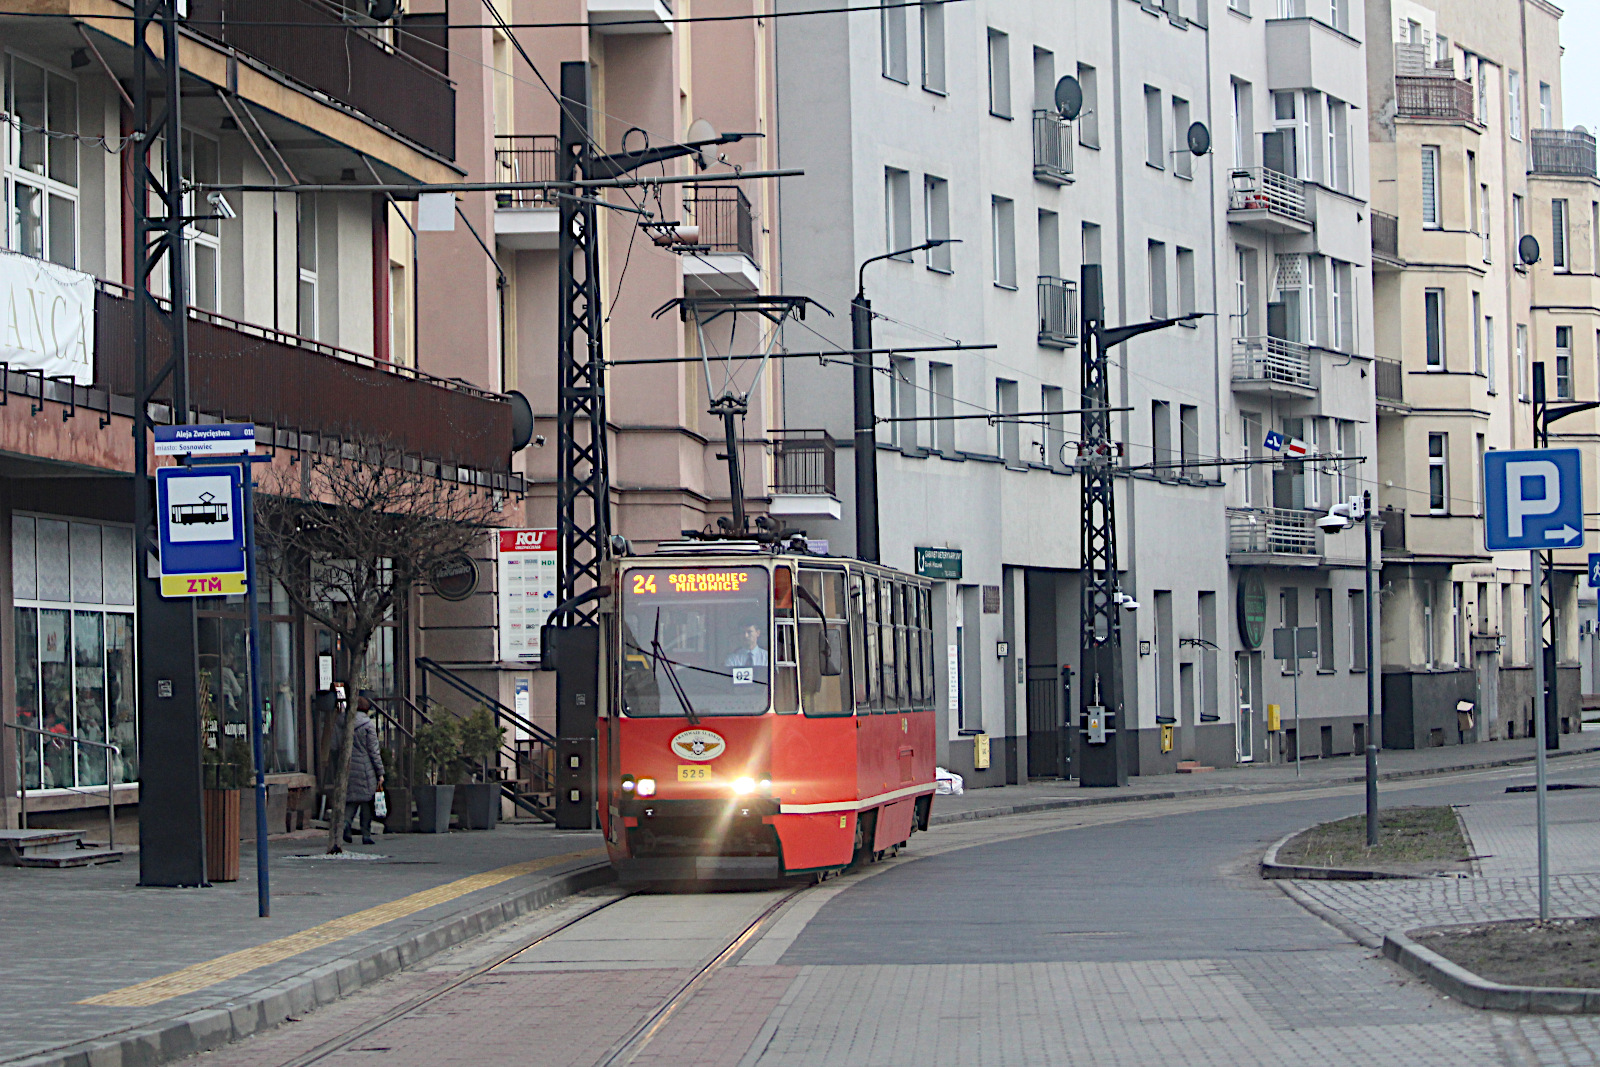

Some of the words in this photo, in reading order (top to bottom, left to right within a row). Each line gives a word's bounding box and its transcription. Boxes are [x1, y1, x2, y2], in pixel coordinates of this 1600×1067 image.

[176, 430, 192, 439] Aleja
[193, 429, 230, 438] Zwycięstwa
[1506, 460, 1560, 537] P
[515, 531, 544, 545] RCU
[668, 572, 748, 584] SOSNOWIEC
[187, 577, 222, 592] ZTM
[633, 574, 657, 594] 24
[675, 581, 740, 592] MILOWICE
[1000, 644, 1005, 652] 6
[735, 671, 750, 681] 02
[682, 769, 705, 778] 525
